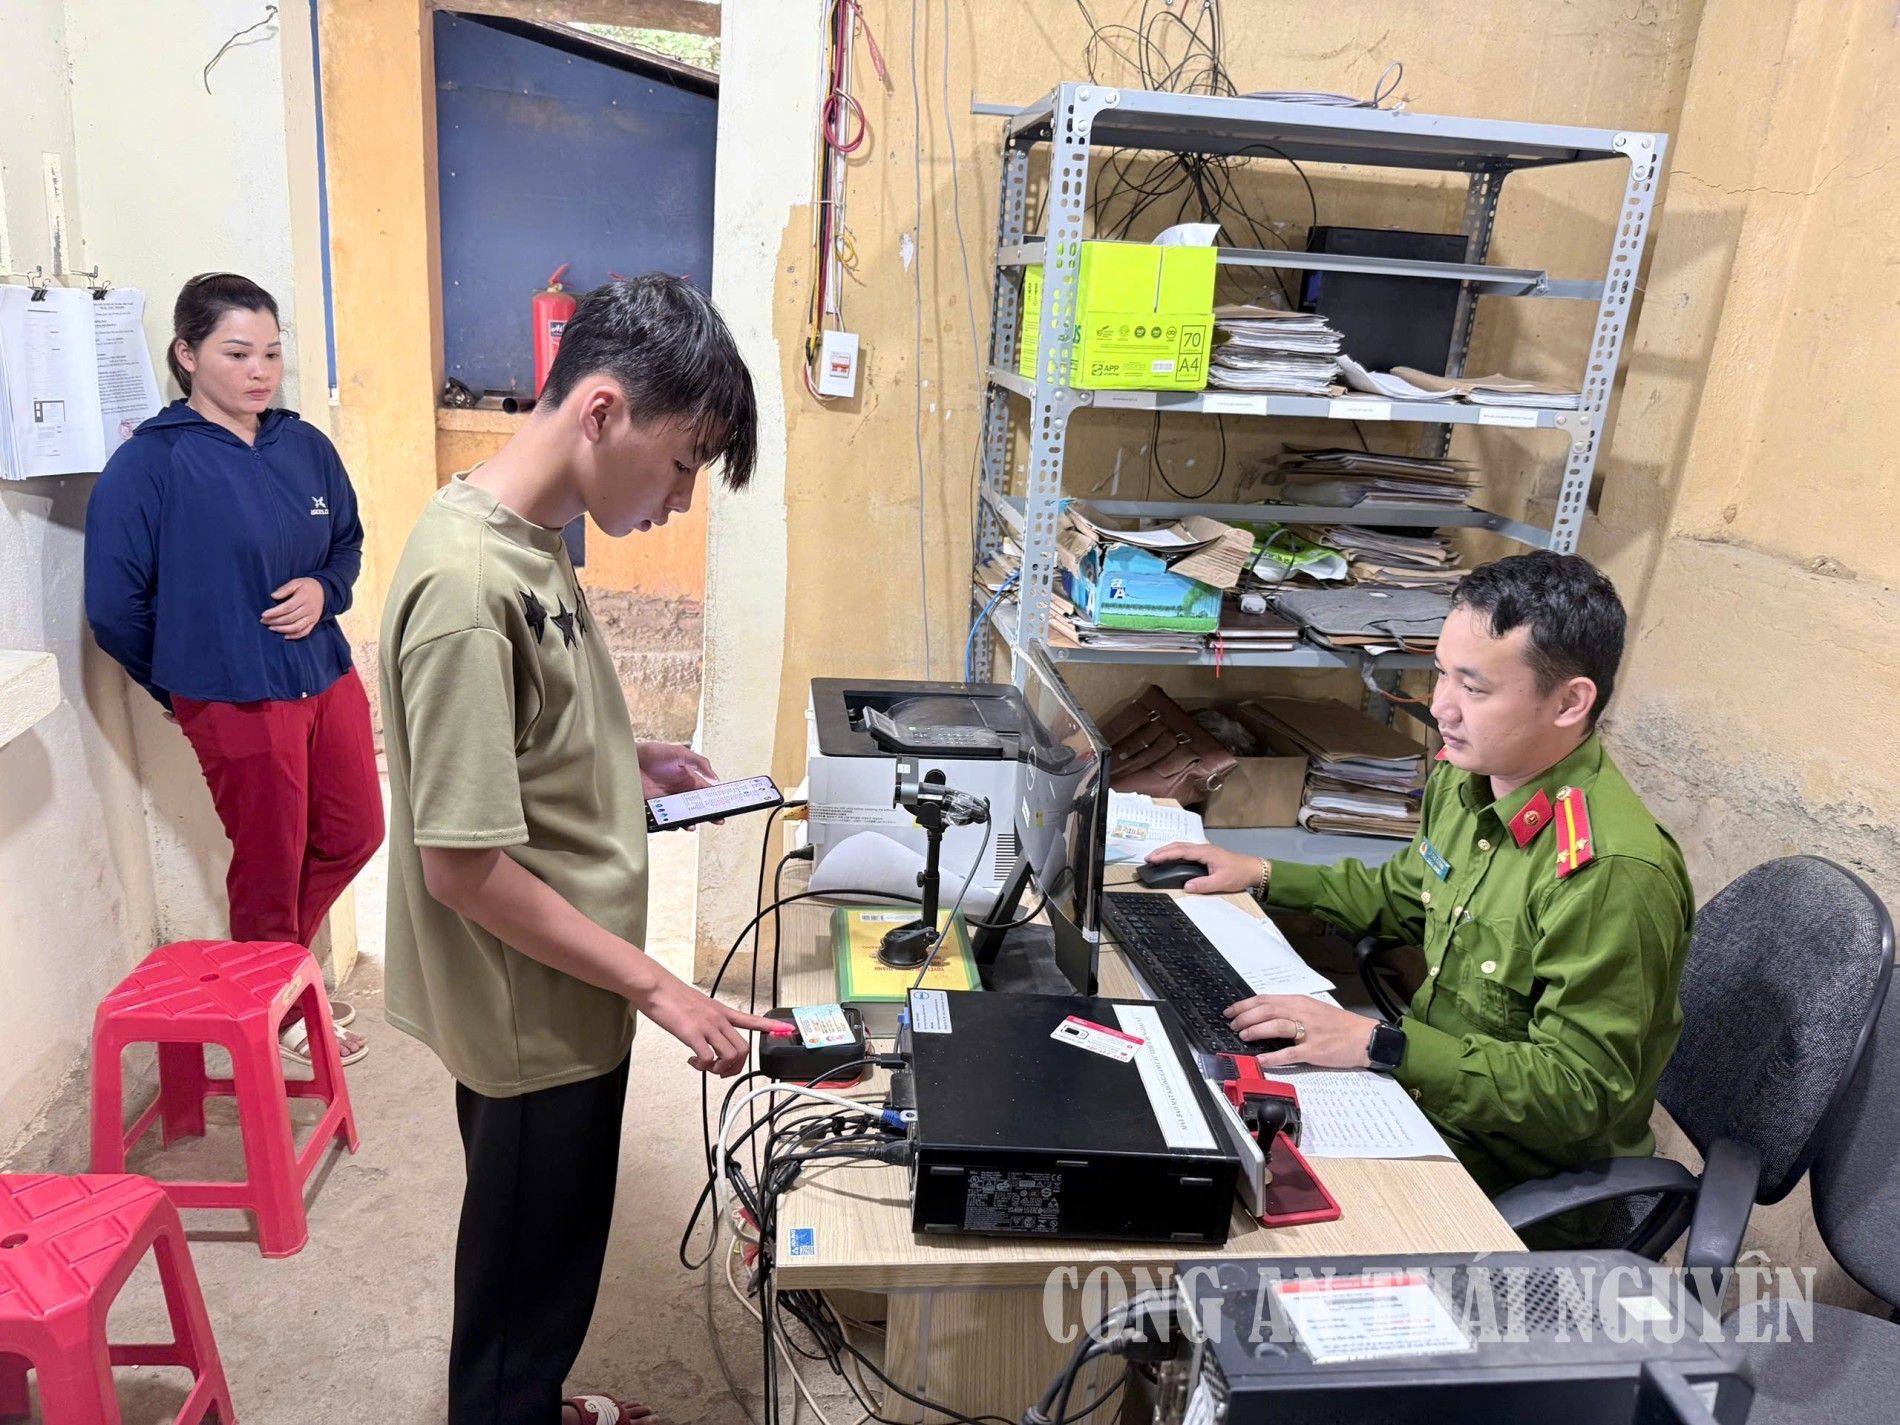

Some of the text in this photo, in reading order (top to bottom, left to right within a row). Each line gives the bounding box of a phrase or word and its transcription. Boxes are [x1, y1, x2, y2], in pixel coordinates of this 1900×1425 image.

[1183, 332, 1202, 348] 70
[1103, 364, 1120, 373] APP
[1178, 357, 1200, 373] A4
